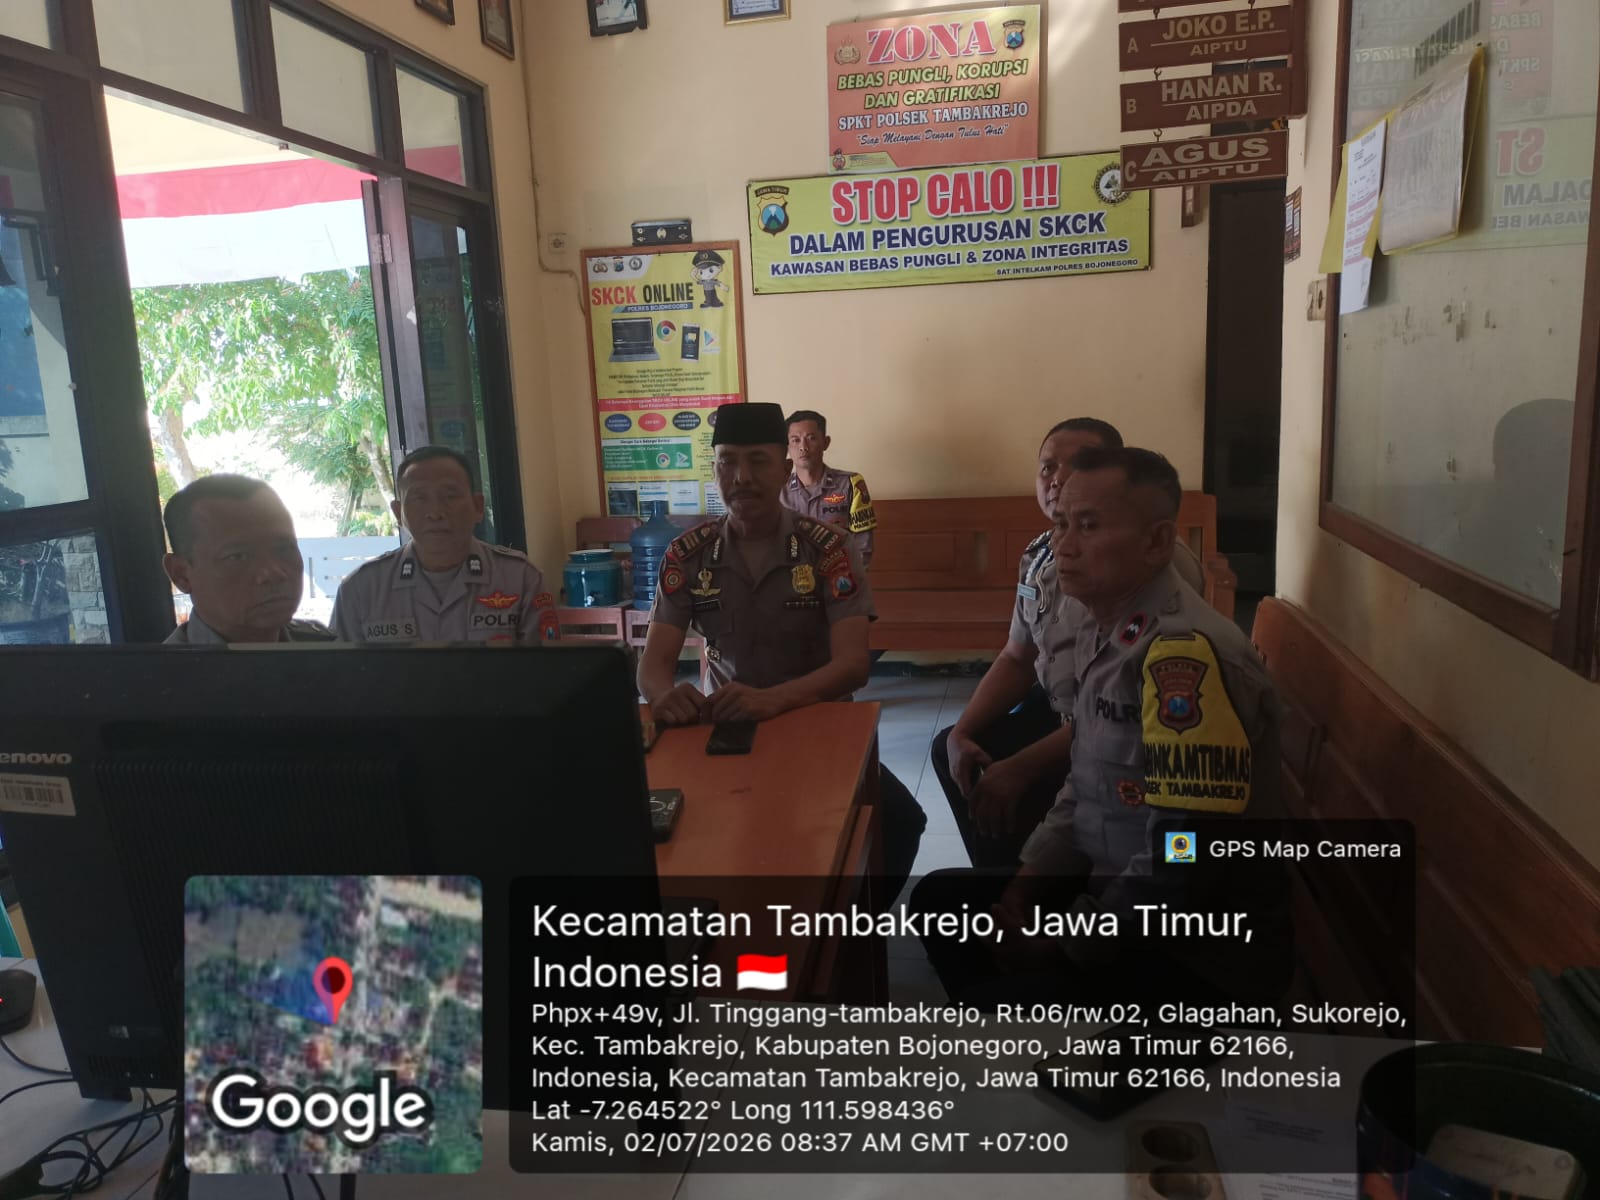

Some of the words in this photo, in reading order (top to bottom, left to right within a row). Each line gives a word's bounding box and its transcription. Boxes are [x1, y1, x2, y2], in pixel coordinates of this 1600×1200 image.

[1162, 14, 1228, 41] JOKO
[1235, 9, 1275, 33] E.P.
[866, 20, 996, 65] ZONA
[1127, 37, 1139, 54] A
[1190, 40, 1247, 57] AIPTU
[837, 71, 883, 91] BEBAS
[887, 67, 952, 87] PUNGLI,
[956, 59, 1029, 79] KORUPSI
[1161, 74, 1249, 102] HANAN
[1258, 71, 1283, 93] R.
[863, 92, 899, 109] DAN
[903, 83, 1000, 105] GRATIFIKASI
[1126, 98, 1137, 115] B
[838, 110, 873, 131] SPKT
[877, 108, 929, 128] POLSEK
[933, 102, 1029, 124] TAMBAKREJO
[1185, 100, 1258, 121] AIPDA
[925, 129, 955, 142] Dengan
[1142, 138, 1270, 168] AGUS
[1124, 160, 1137, 183] C
[1152, 163, 1260, 183] AIPTU
[831, 177, 919, 224] STOP
[927, 170, 1015, 218] CALO
[1021, 163, 1060, 208] !!!
[790, 229, 866, 255] DALAM
[872, 218, 1031, 251] PENGURUSAN
[1039, 211, 1107, 237] SKCK
[770, 261, 844, 277] KAWASAN
[849, 256, 899, 273] BEBAS
[904, 252, 961, 268] PUNGLI
[966, 251, 978, 264] &
[982, 247, 1024, 263] ZONA
[1031, 238, 1128, 260] INTEGRITAS
[1013, 266, 1052, 275] INTELKAM
[1053, 263, 1083, 272] POLRES
[1085, 259, 1138, 269] BOJONEGORO
[591, 284, 638, 306] SKCK
[643, 281, 694, 304] ONLINE
[367, 623, 399, 639] AGUS
[404, 622, 414, 636] S
[1166, 782, 1246, 801] TAMBAKREJO
